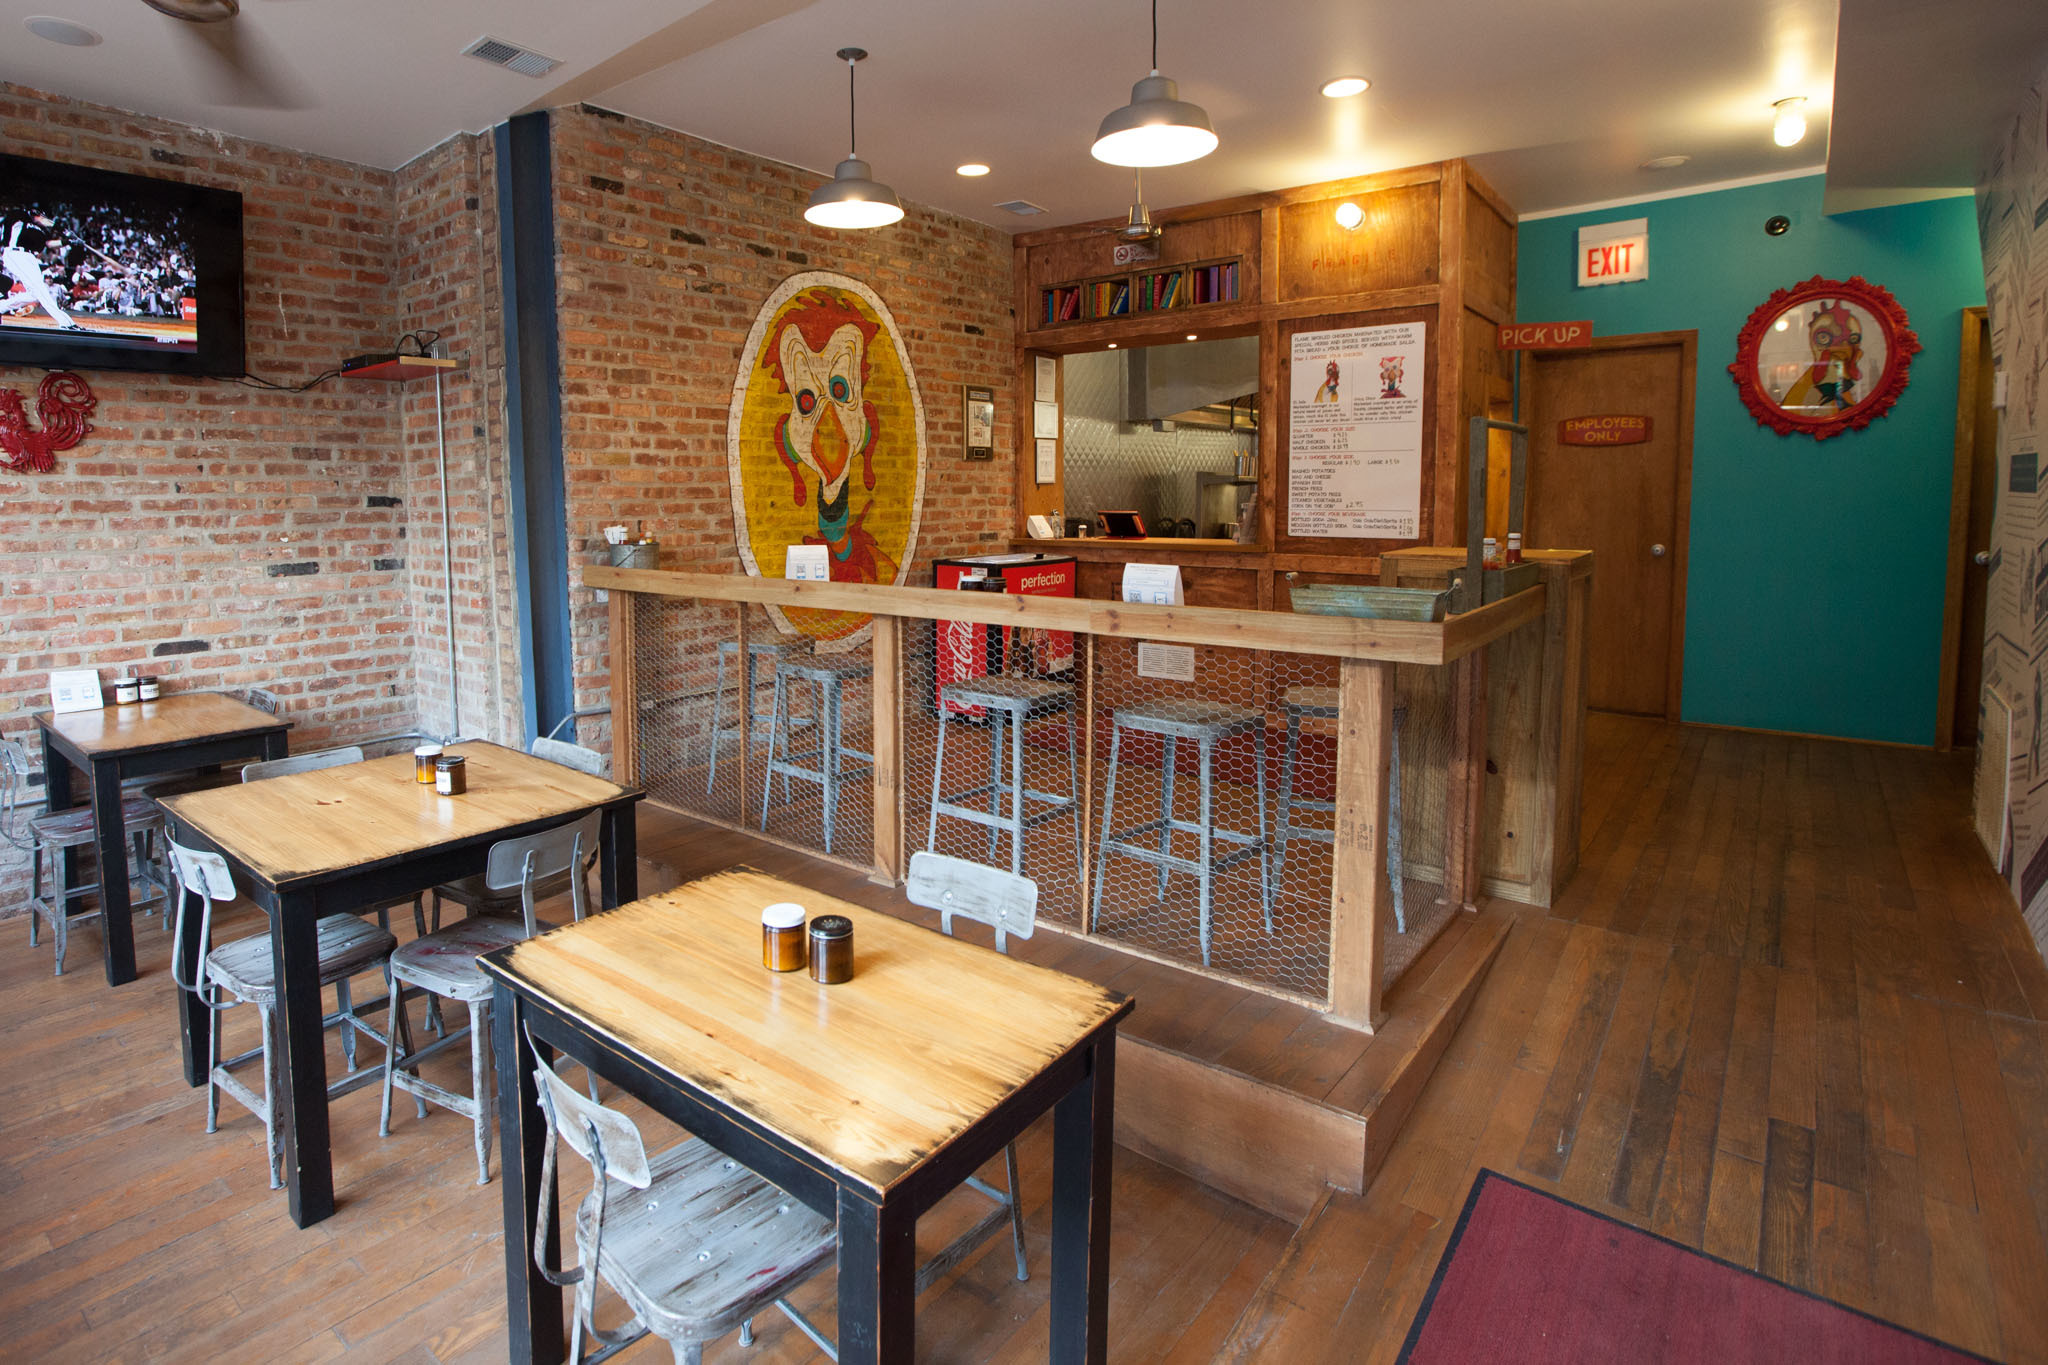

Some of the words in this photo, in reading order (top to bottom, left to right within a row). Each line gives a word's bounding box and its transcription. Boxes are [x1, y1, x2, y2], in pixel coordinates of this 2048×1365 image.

[1587, 243, 1635, 278] EXIT
[1502, 327, 1547, 345] PICK
[1553, 326, 1581, 344] UP
[1566, 416, 1645, 431] EMPLOYEES
[1584, 430, 1622, 443] ONLY
[1021, 571, 1066, 591] perfection
